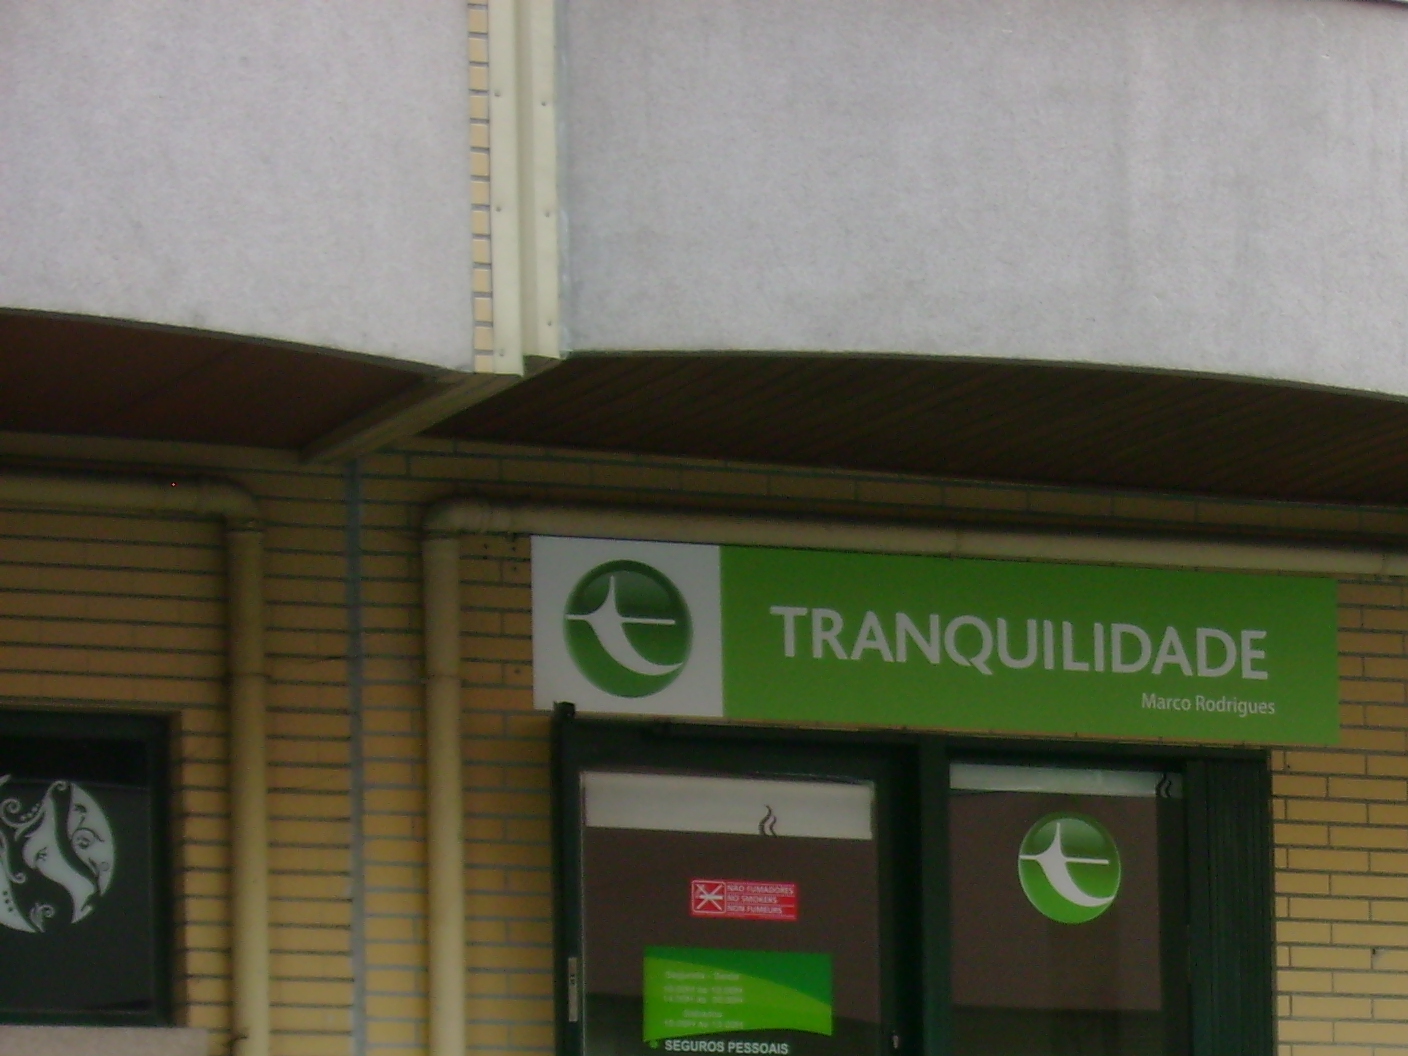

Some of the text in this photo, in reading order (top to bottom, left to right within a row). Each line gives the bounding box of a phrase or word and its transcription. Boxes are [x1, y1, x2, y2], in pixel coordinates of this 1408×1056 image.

[770, 605, 1269, 681] TRANQUILIDADE
[1142, 692, 1275, 718] Marco Rodrigues
[664, 1039, 789, 1055] SEGUROS PESSOAIS
